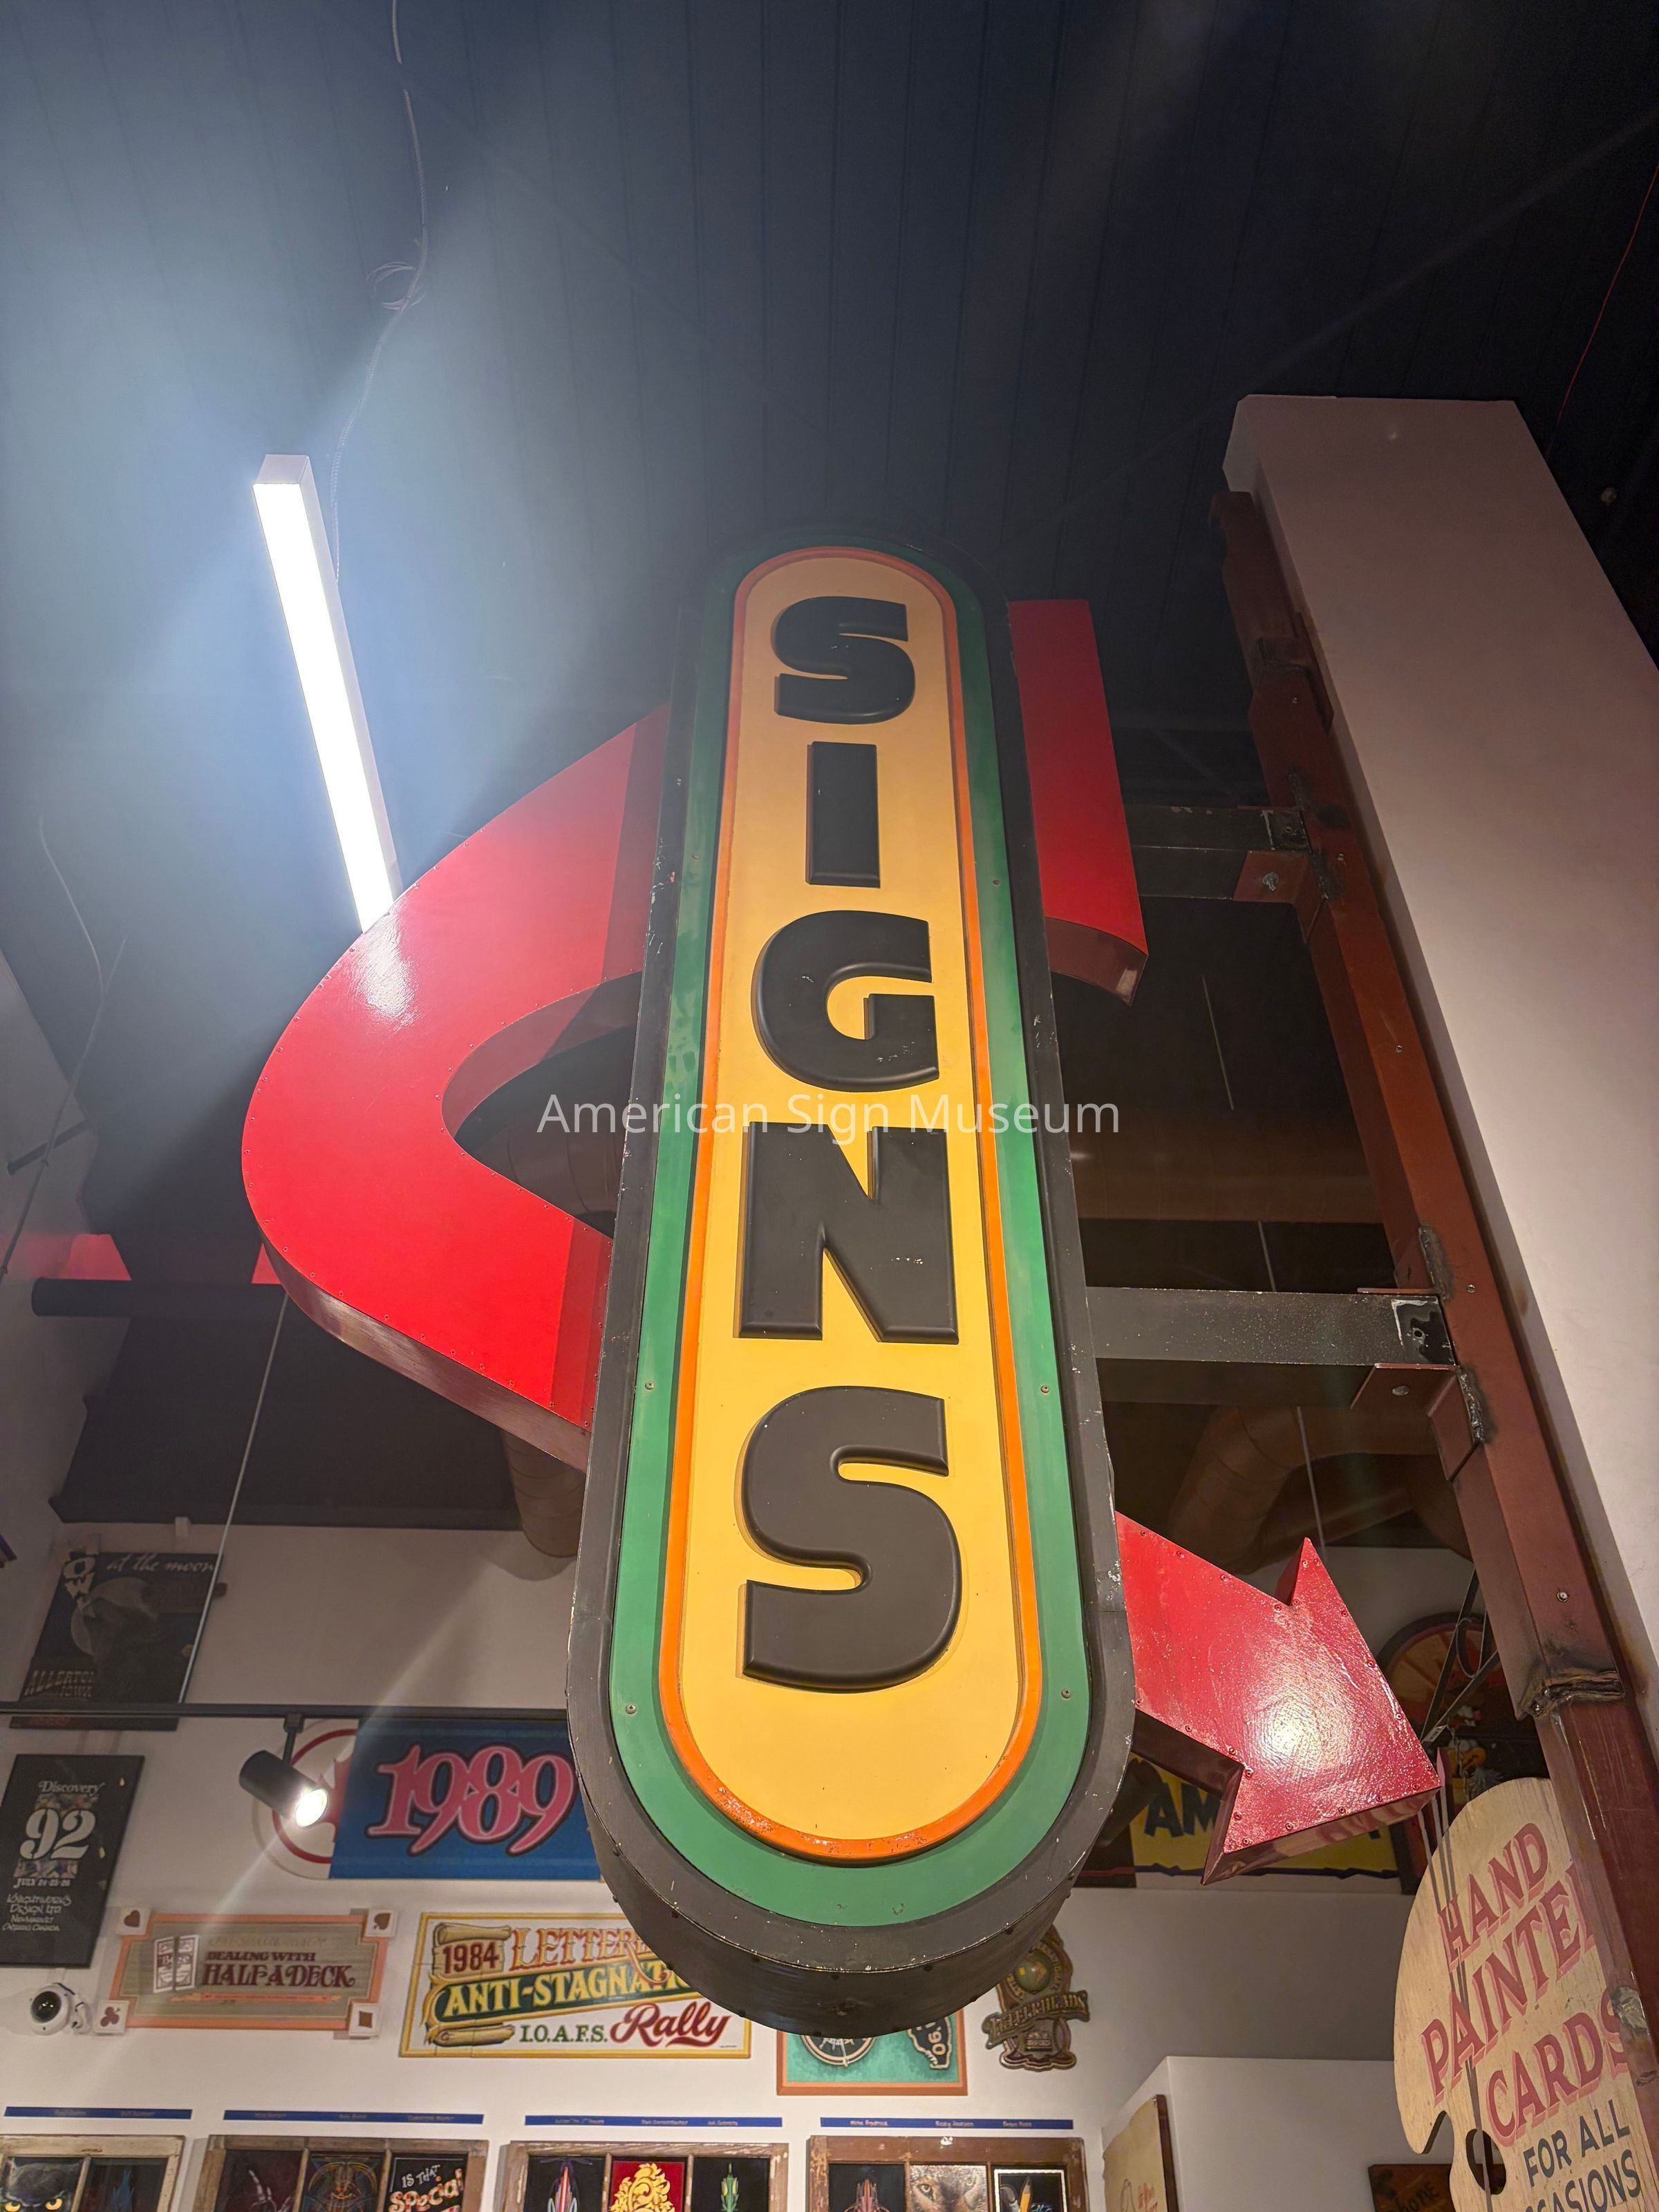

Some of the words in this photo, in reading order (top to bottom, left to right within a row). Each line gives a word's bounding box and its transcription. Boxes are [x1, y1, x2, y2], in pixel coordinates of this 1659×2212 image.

[734, 596, 963, 1694] SIGNS
[132, 1553, 159, 1571] the
[38, 1780, 106, 1797] Discovery
[364, 1743, 577, 1856] 1989
[19, 1808, 96, 1859] 92
[1438, 1823, 1548, 1971] HAND
[206, 1951, 269, 1962] DEALING
[272, 1952, 316, 1962] WITH
[285, 1965, 356, 1988] DECK
[442, 1941, 500, 1974] 1984
[519, 2025, 608, 2043] I.O.A.F.S.
[610, 2002, 733, 2047] Rally
[1523, 2130, 1572, 2188] FOR
[1580, 2099, 1631, 2158] ALL
